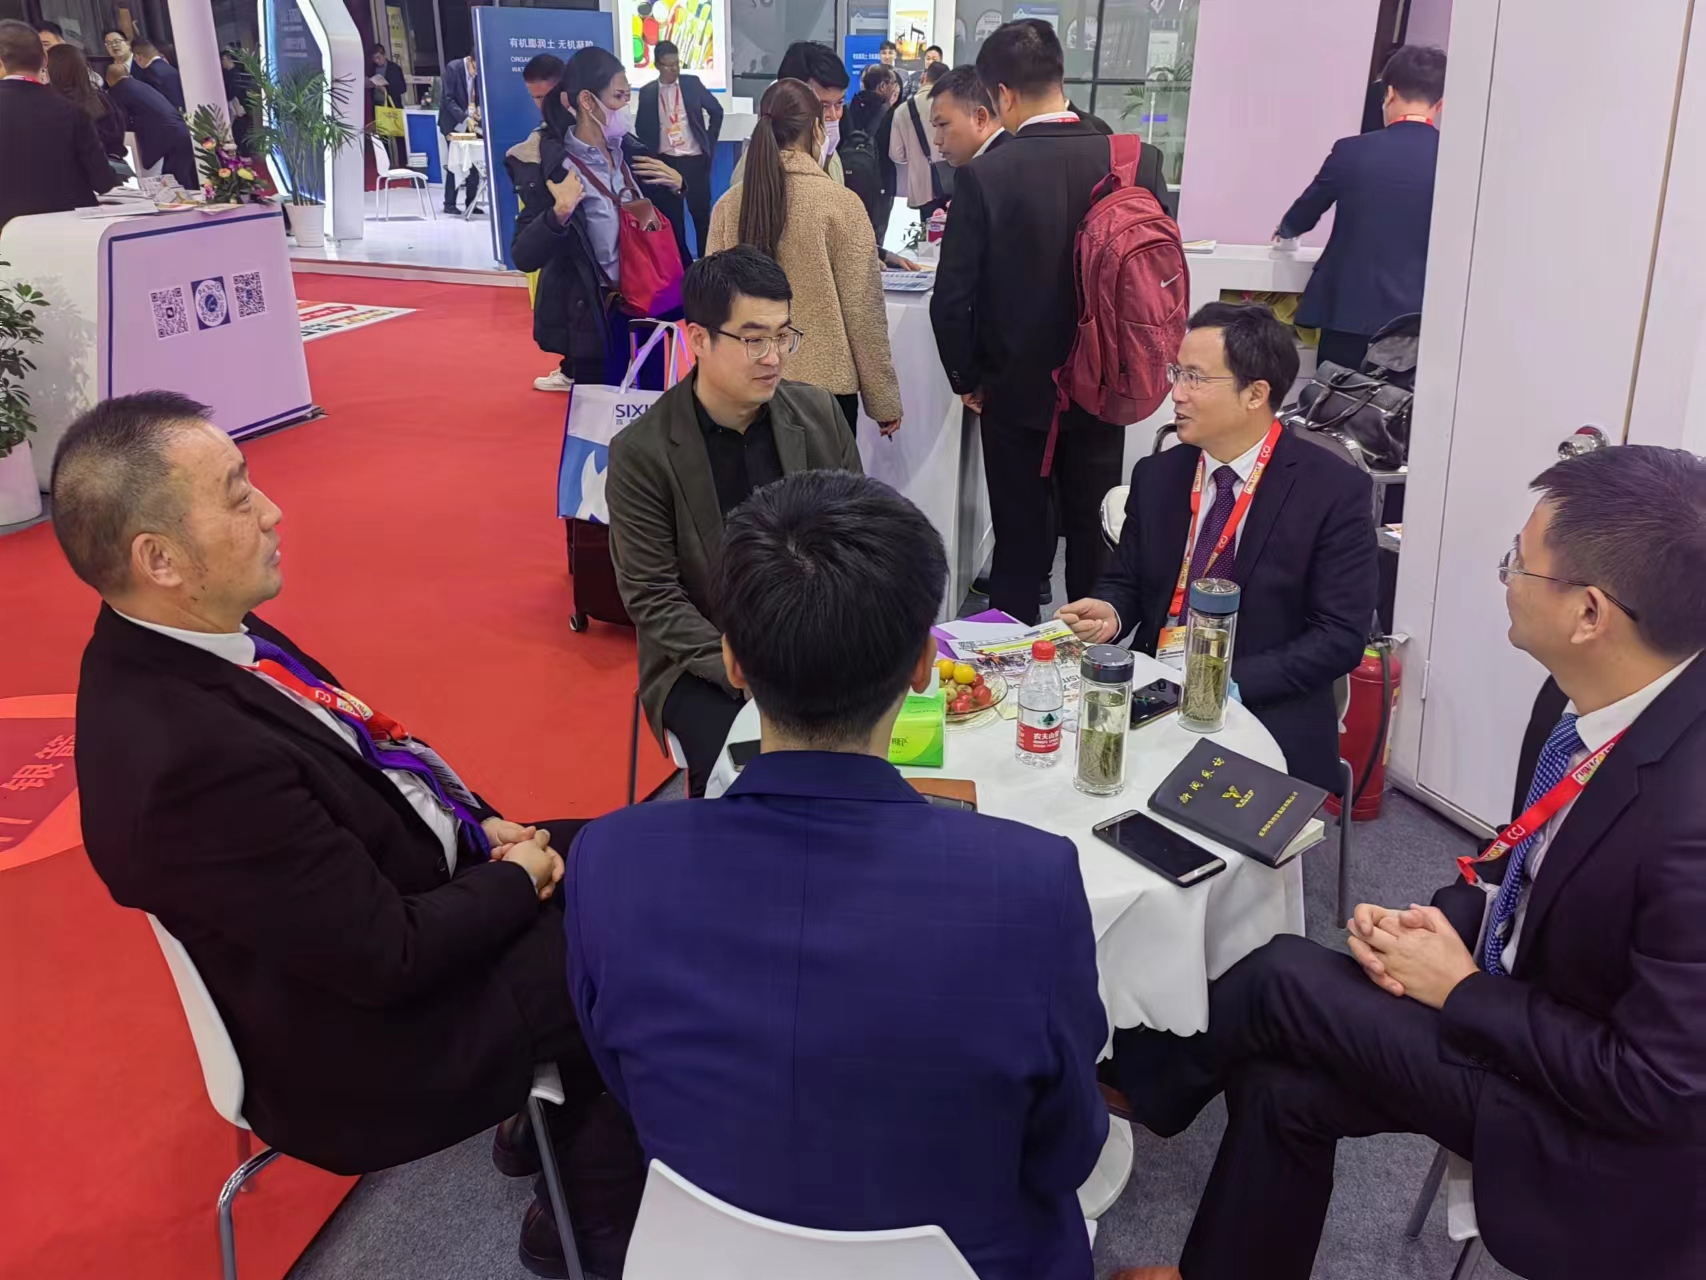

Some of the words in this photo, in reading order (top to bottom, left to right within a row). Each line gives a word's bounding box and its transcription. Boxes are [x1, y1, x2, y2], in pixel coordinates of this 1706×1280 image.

[509, 38, 555, 49] 有机膨润土
[1506, 824, 1526, 841] CCJ
